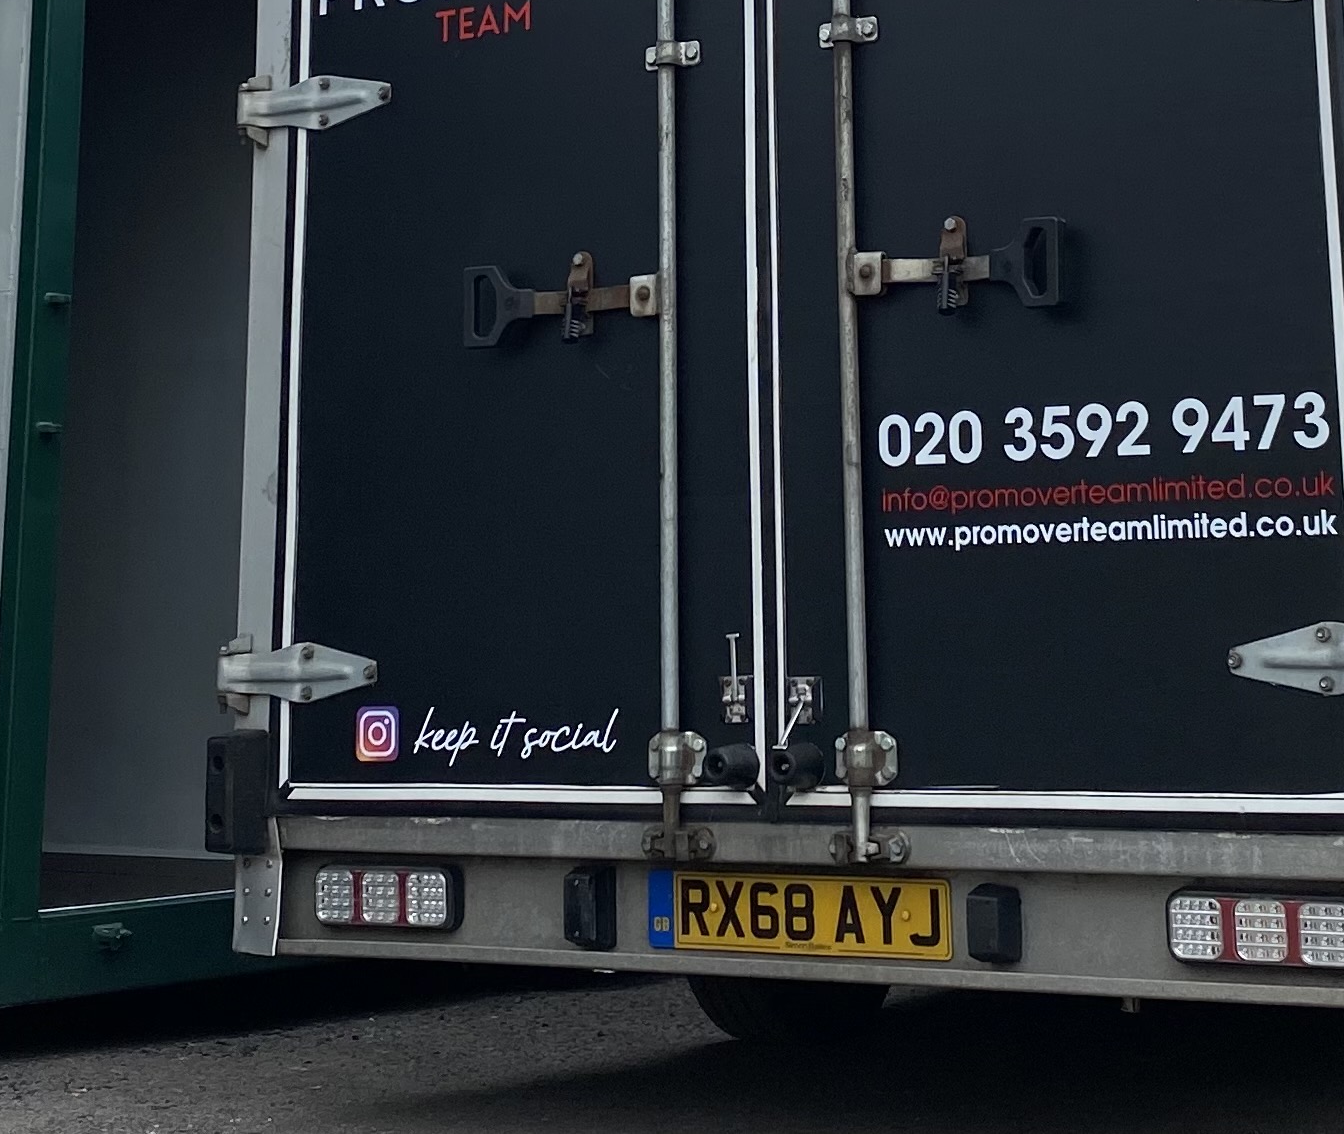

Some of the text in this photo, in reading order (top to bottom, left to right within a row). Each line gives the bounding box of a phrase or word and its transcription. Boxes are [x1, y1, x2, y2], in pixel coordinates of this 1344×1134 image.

[436, 0, 532, 43] TEAM
[878, 391, 1330, 467] 020 3592 9473
[882, 470, 1335, 514] info@promoverteamlimited.co.uk
[884, 509, 1339, 552] www.promoverteamlimited.co.uk
[413, 706, 619, 767] keep it social
[681, 879, 941, 947] RX68 AYJ
